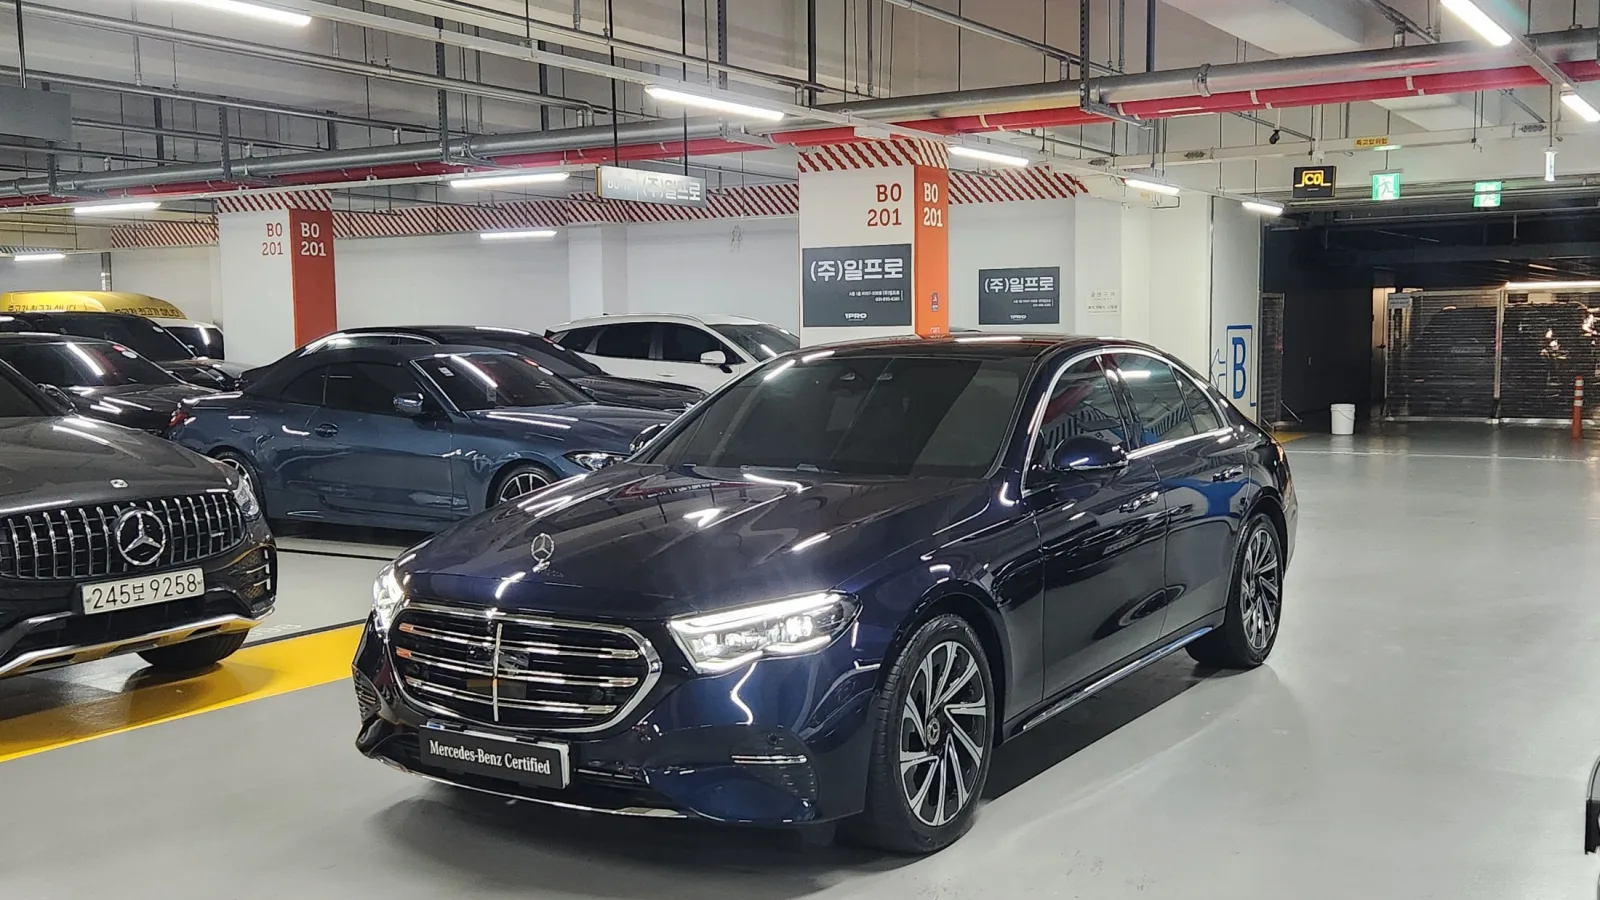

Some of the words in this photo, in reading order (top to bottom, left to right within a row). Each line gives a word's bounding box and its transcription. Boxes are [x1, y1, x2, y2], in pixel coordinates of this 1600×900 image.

[867, 207, 902, 227] 201
[923, 206, 943, 228] 201
[261, 241, 284, 256] 201
[300, 240, 327, 257] 201
[810, 258, 903, 282] (주)일프로
[984, 276, 1054, 293] (주)일프로
[1232, 336, 1247, 399] B
[92, 582, 146, 609] 245보
[149, 573, 198, 599] 9258
[429, 739, 502, 767] Mercedes-Benz
[504, 753, 551, 775] Certified
